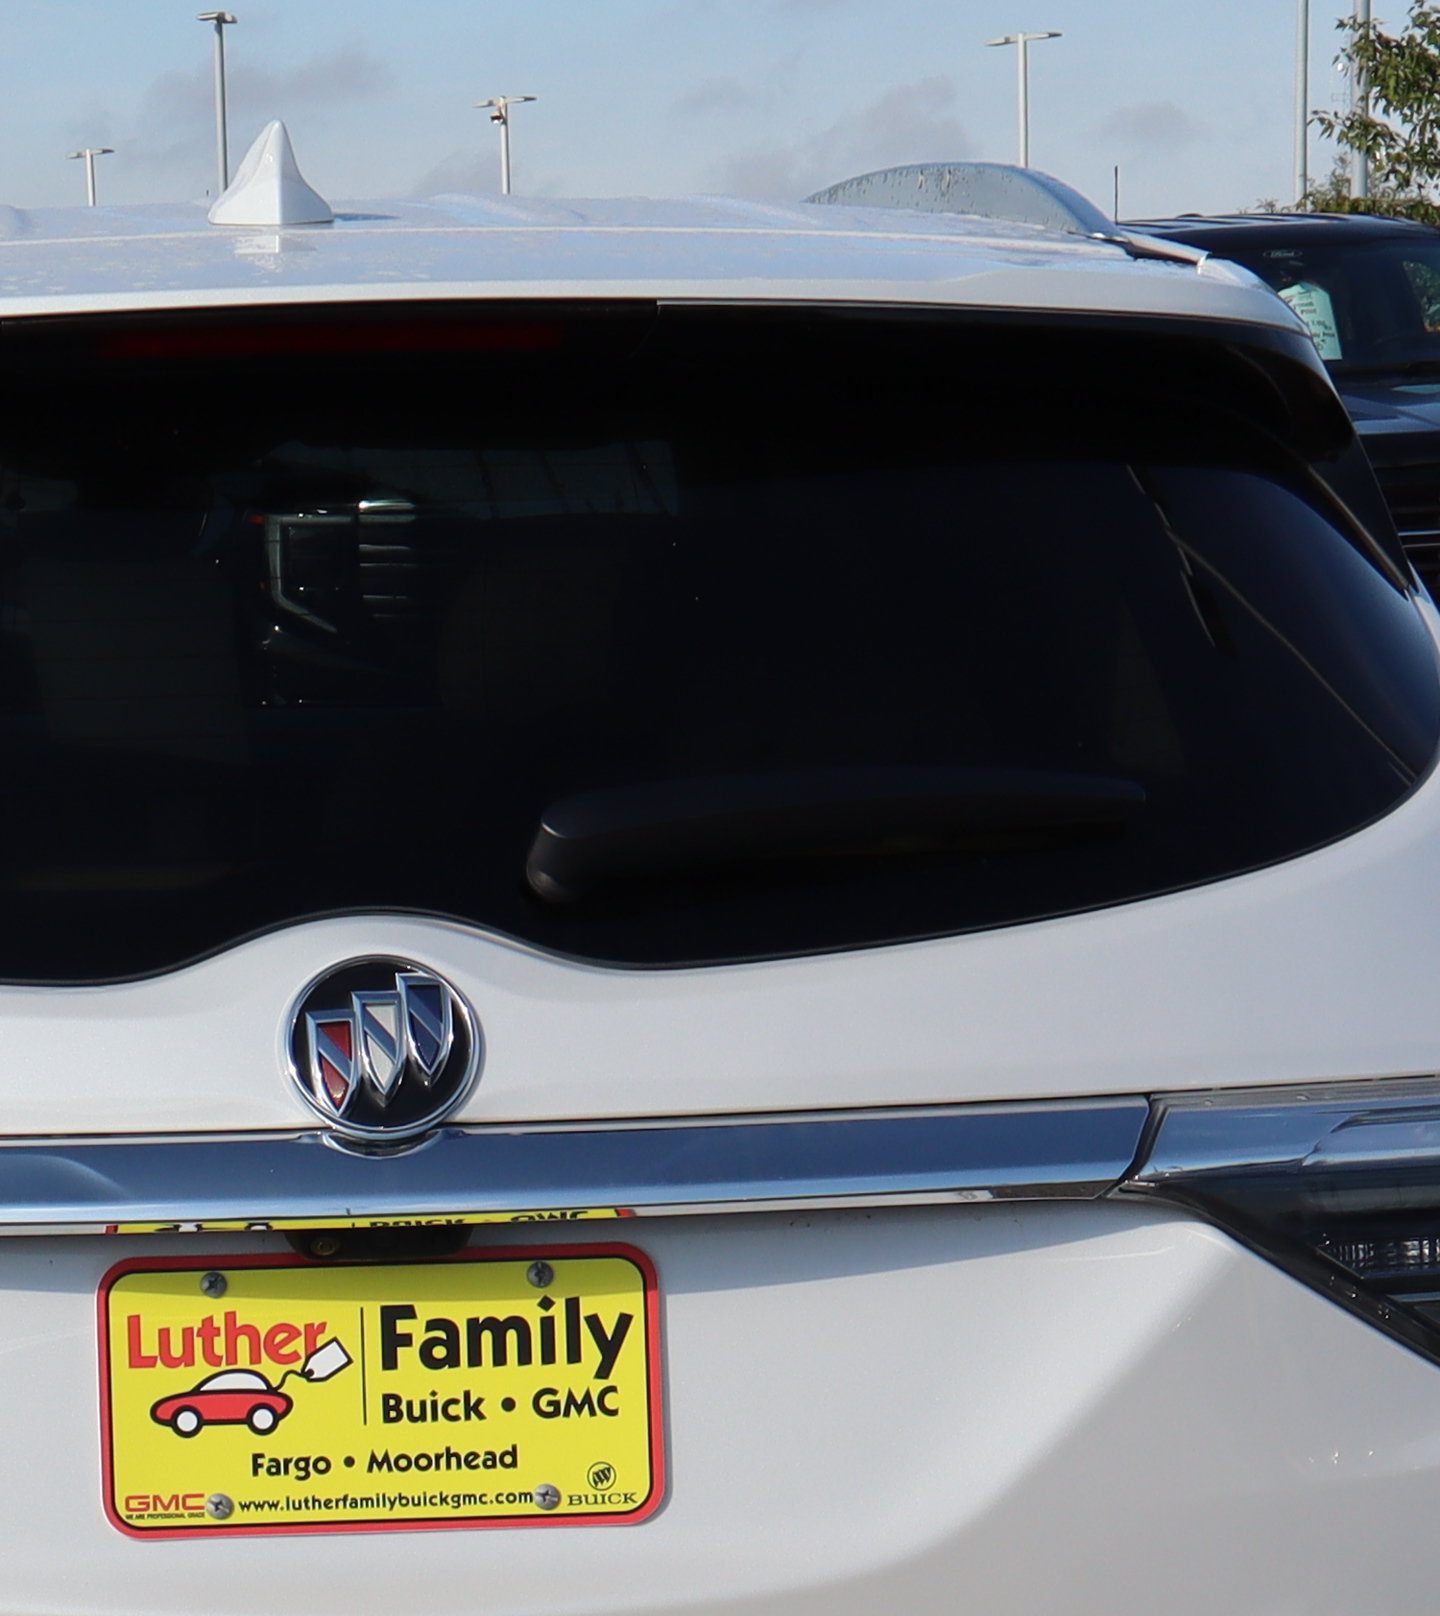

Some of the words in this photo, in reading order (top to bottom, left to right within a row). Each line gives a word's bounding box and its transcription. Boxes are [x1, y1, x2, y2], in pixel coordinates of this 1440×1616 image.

[127, 1310, 328, 1369] Luther
[379, 1294, 634, 1380] Family
[382, 1390, 487, 1424] Buick
[532, 1385, 620, 1419] GMC
[251, 1452, 332, 1481] Fargo
[366, 1444, 518, 1473] Moorhead
[125, 1493, 205, 1512] GMC
[238, 1490, 533, 1513] www.lutherfamilybuickgmc.com
[567, 1491, 639, 1507] BUICK
